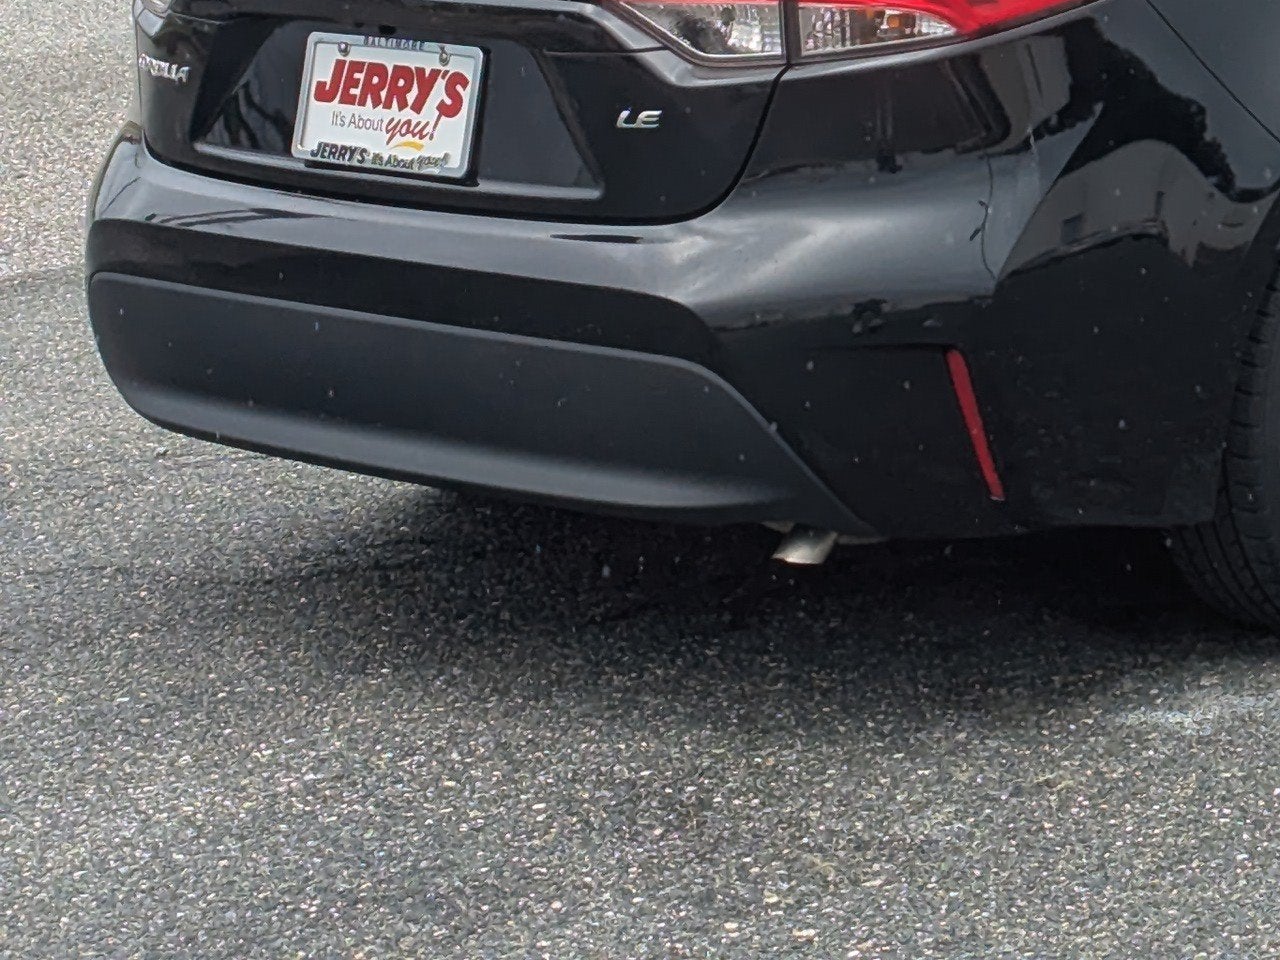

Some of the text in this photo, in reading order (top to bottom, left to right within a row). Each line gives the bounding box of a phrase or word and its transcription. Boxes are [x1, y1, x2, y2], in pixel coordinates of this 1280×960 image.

[313, 58, 470, 119] JERRY'S
[331, 110, 442, 146] It's About you!
[616, 110, 662, 129] LE
[310, 141, 368, 165] JERRY'S
